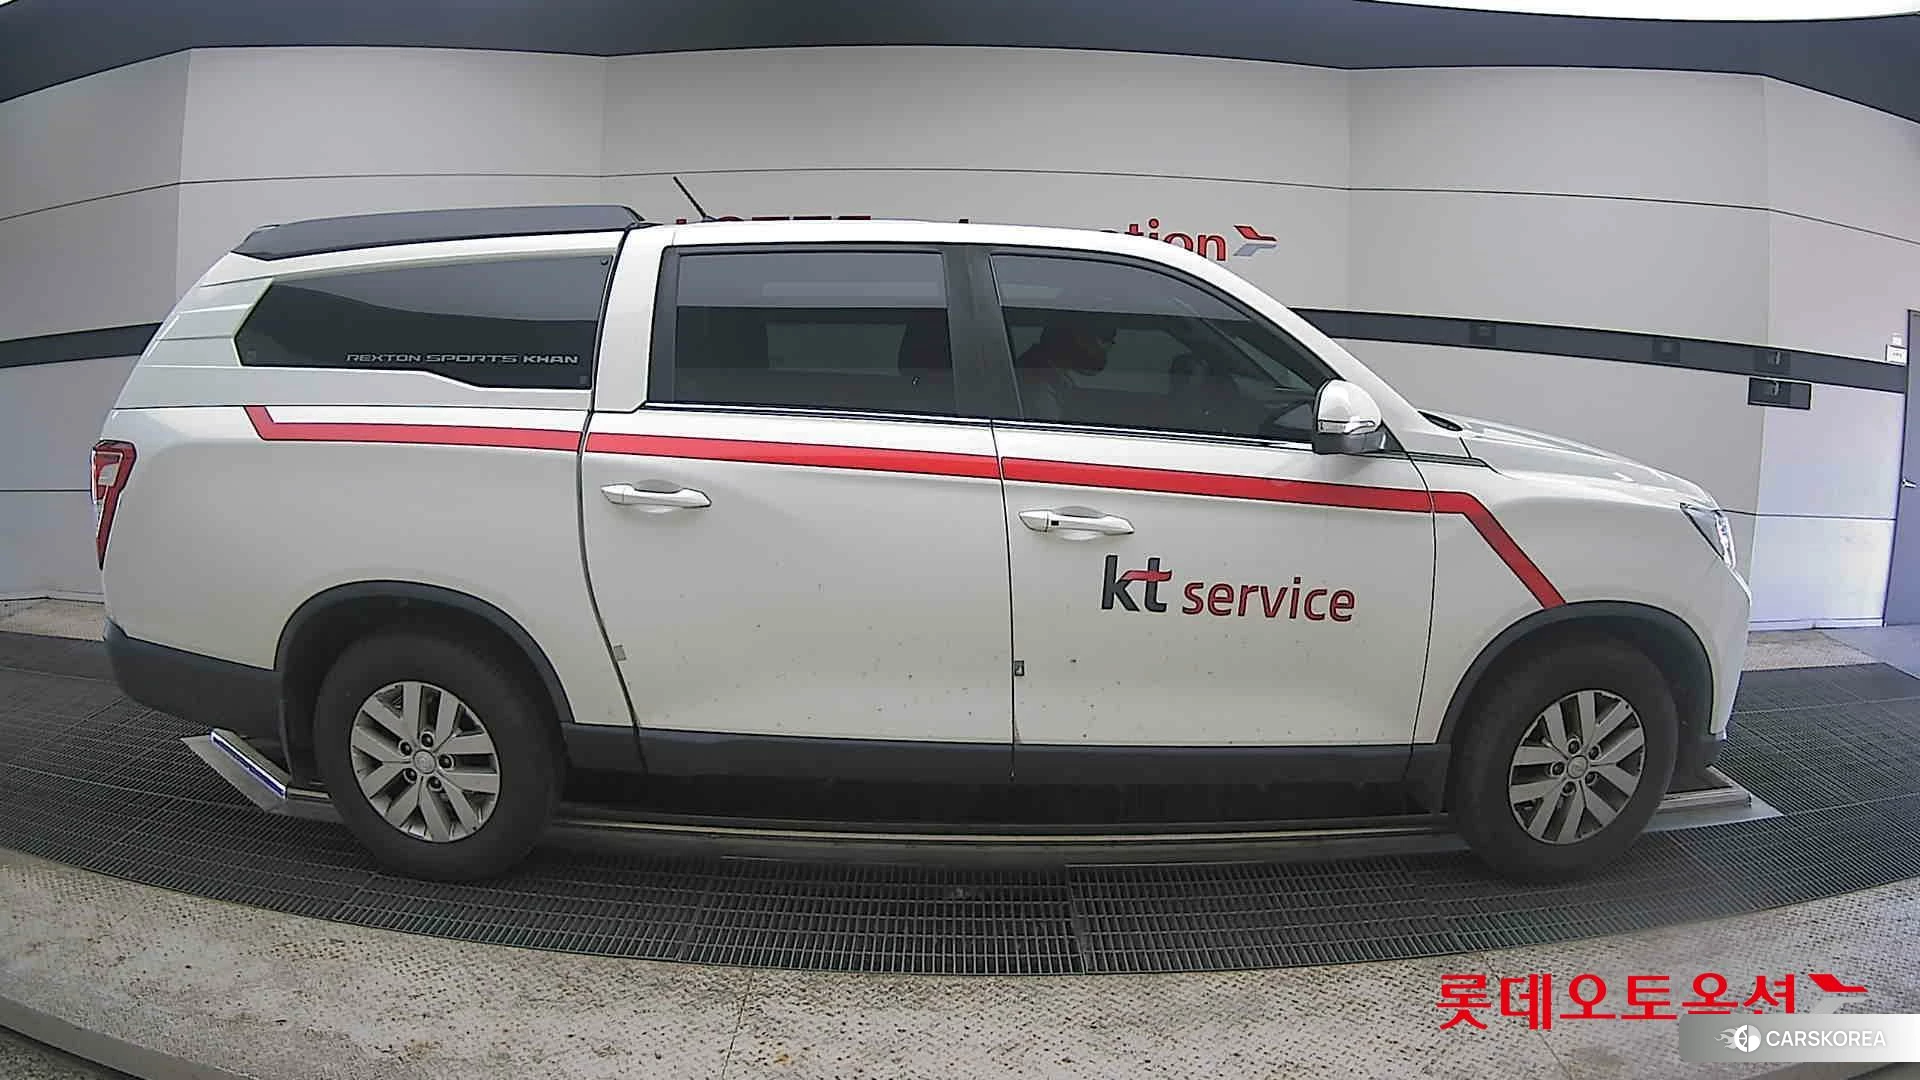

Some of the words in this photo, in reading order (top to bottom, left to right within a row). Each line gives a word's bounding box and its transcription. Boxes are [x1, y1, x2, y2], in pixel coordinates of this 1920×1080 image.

[346, 353, 421, 363] REXTON
[426, 354, 517, 364] SPORTS
[522, 356, 578, 365] KHAN
[1101, 554, 1172, 613] kt
[1182, 576, 1355, 622] service
